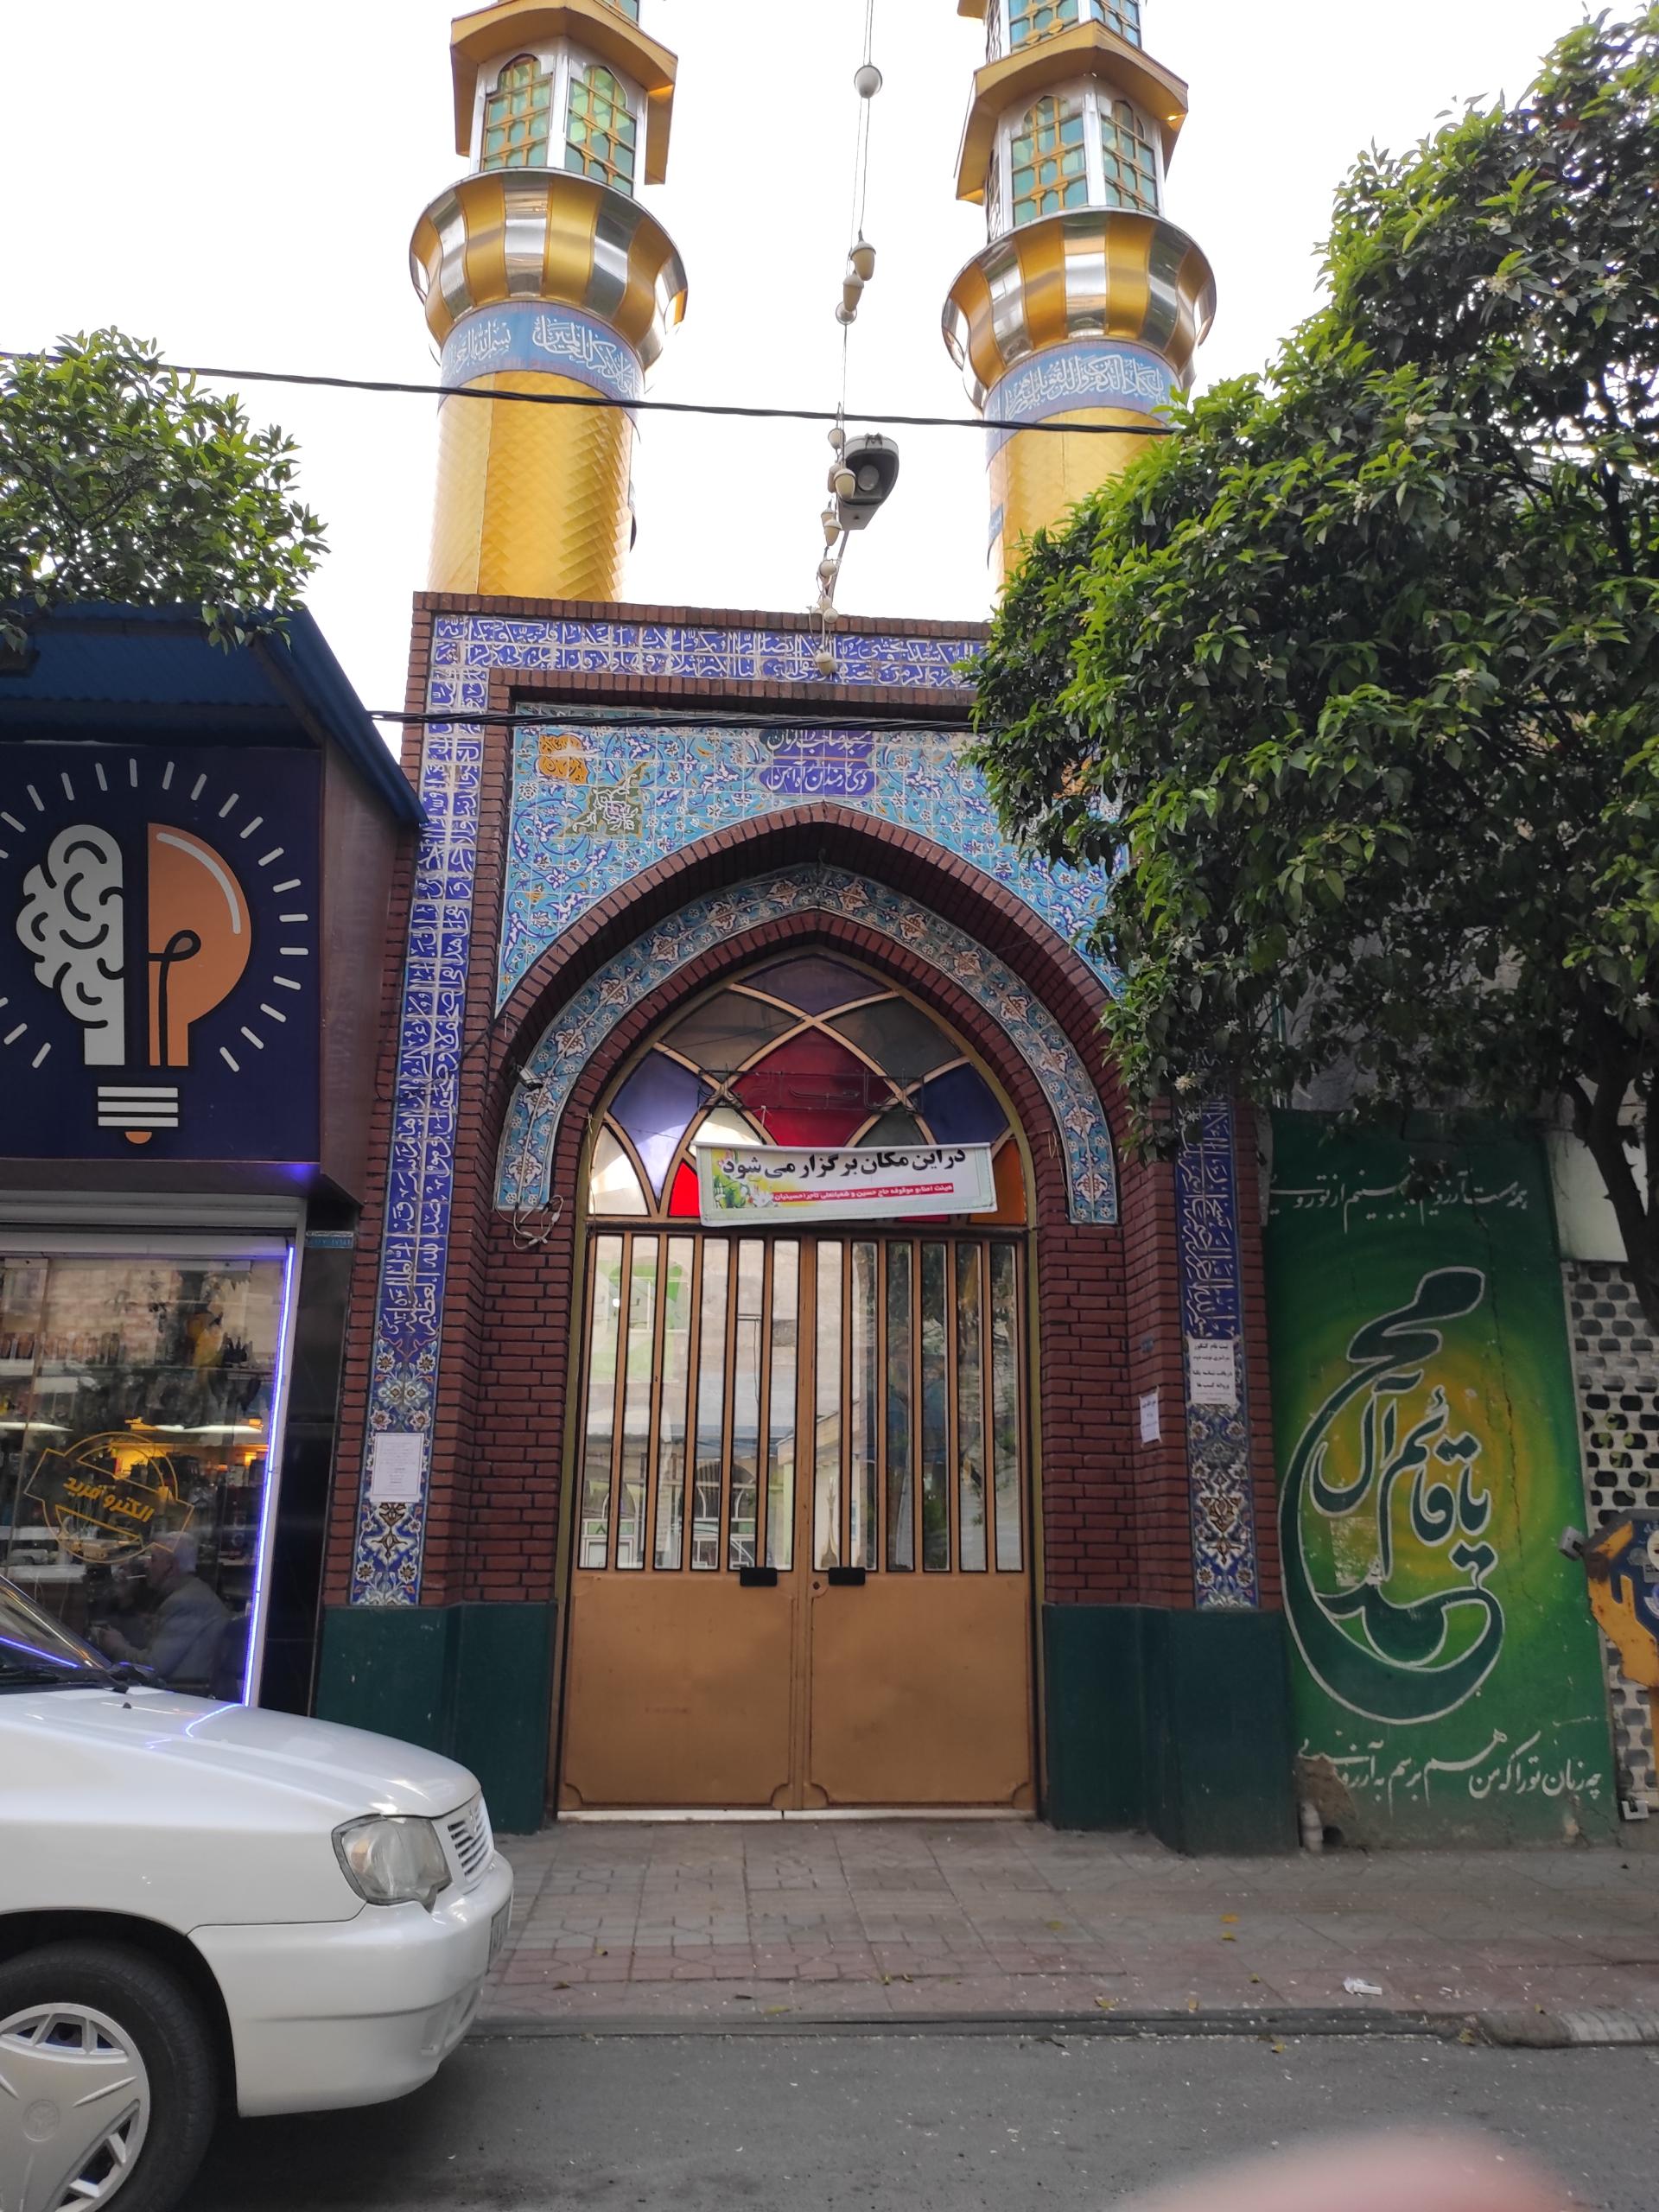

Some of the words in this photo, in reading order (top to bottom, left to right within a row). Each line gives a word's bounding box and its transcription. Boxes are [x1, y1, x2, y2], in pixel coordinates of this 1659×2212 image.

[721, 1156, 762, 1180] شود
[861, 1151, 909, 1175] مکان
[912, 1149, 944, 1171] این
[944, 1147, 966, 1169] در
[764, 1163, 795, 1179] می
